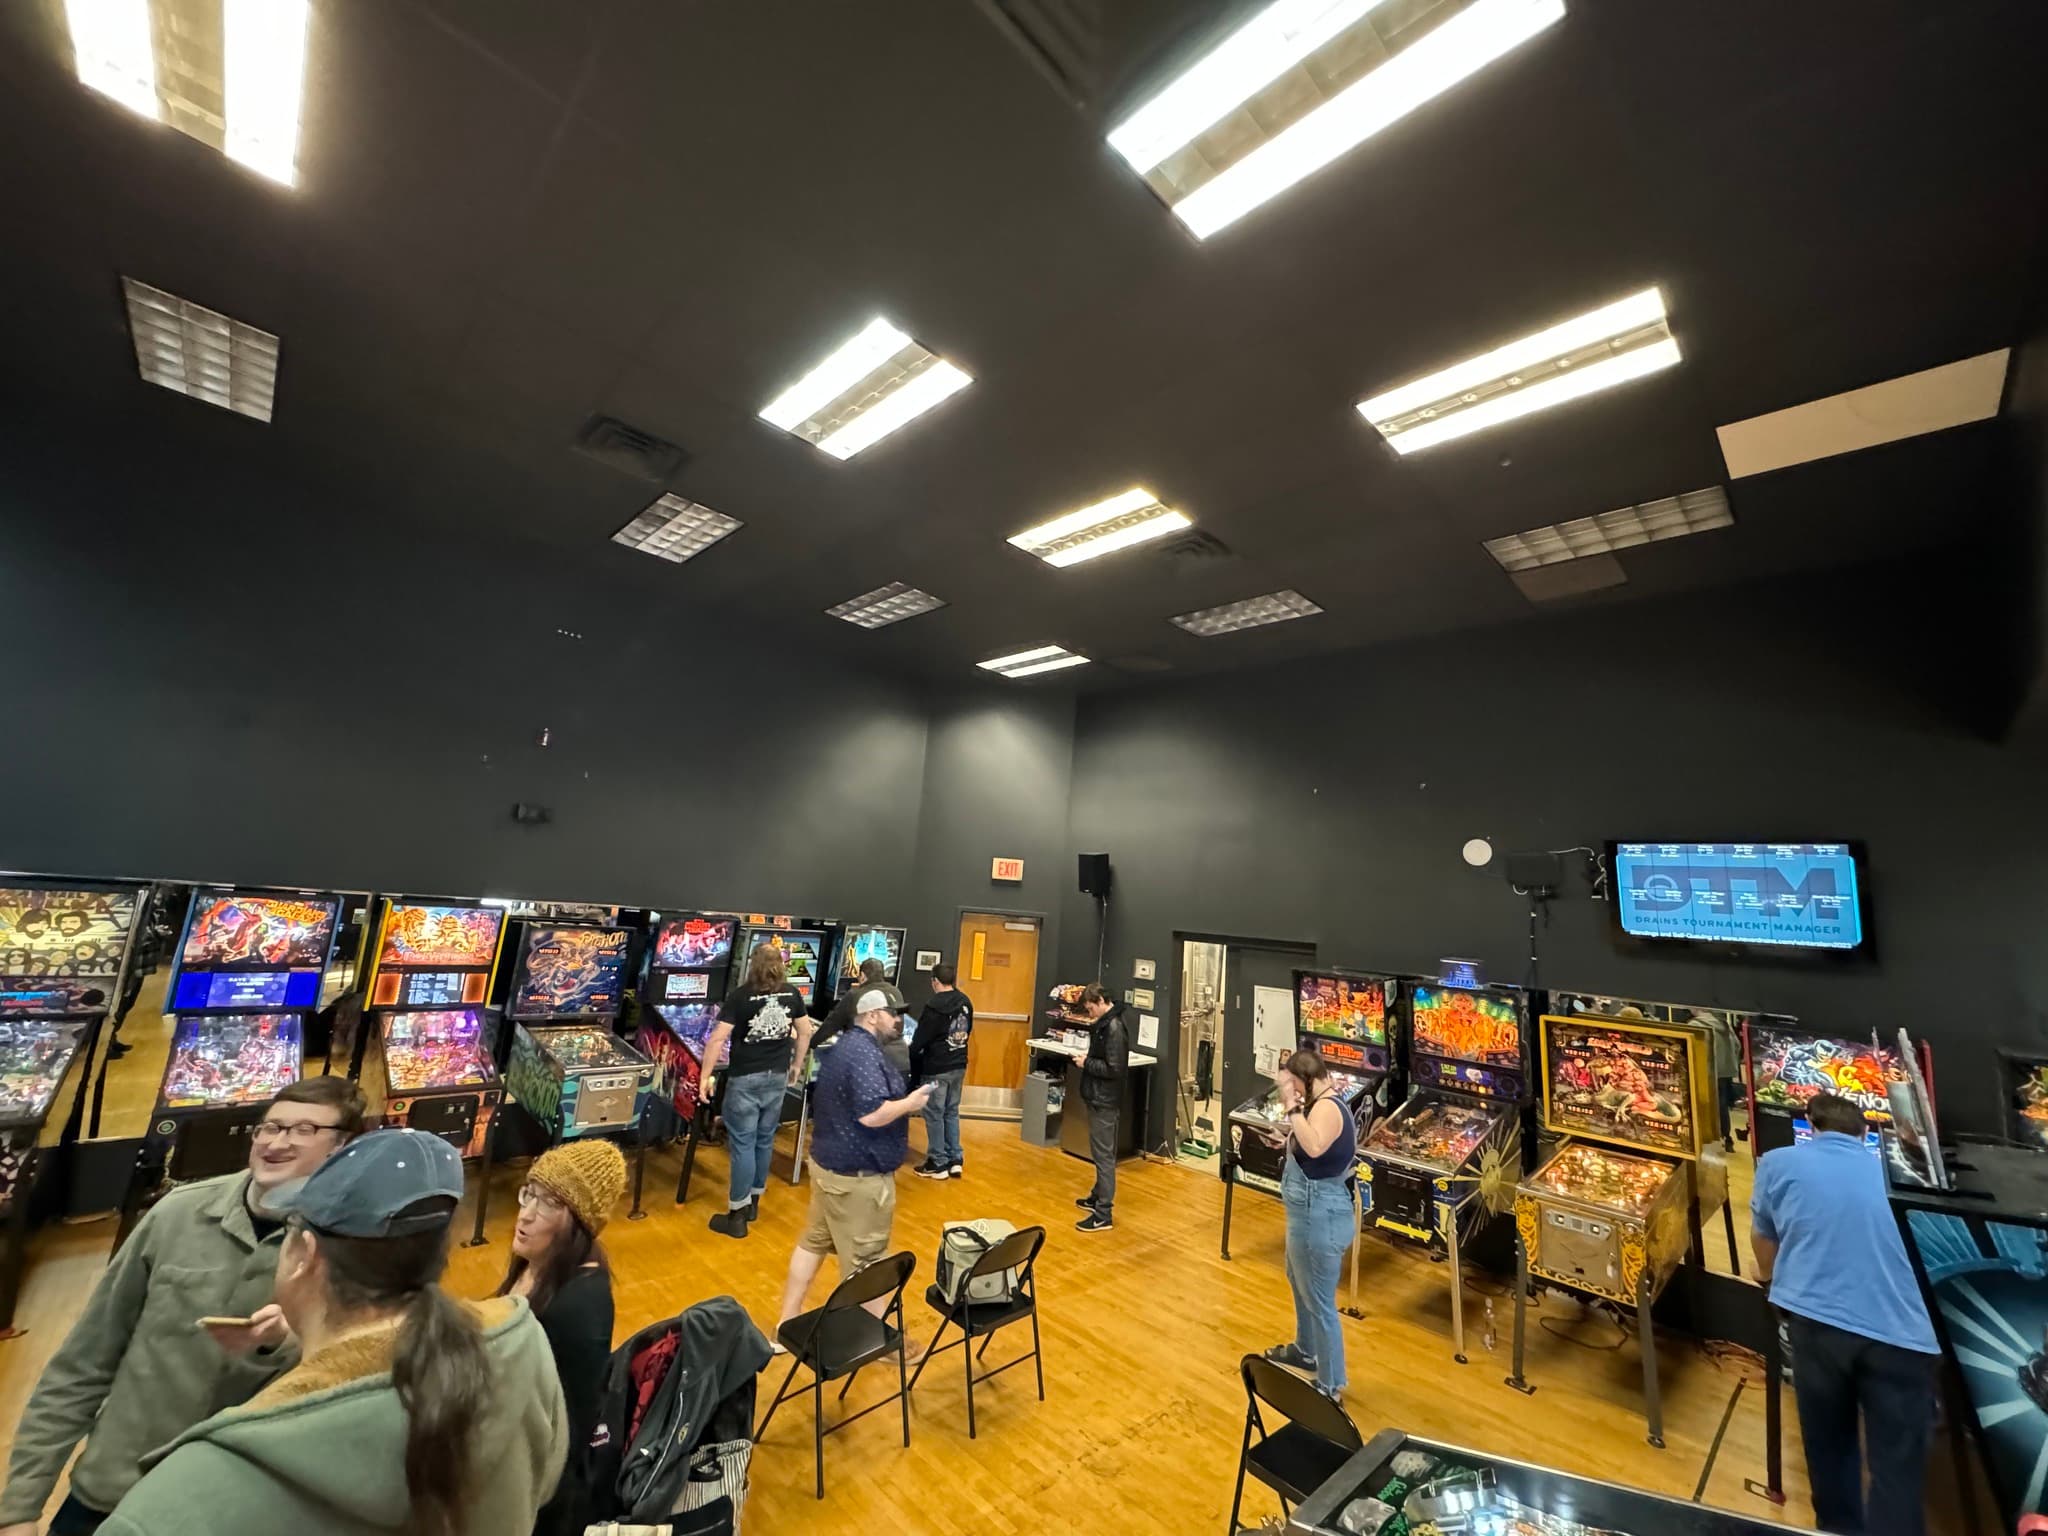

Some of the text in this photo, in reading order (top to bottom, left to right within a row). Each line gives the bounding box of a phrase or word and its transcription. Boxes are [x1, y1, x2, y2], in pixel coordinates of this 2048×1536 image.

[998, 861, 1019, 877] EXIT
[1635, 915, 1841, 935] DRAINS TOURNAMENT MANAGER
